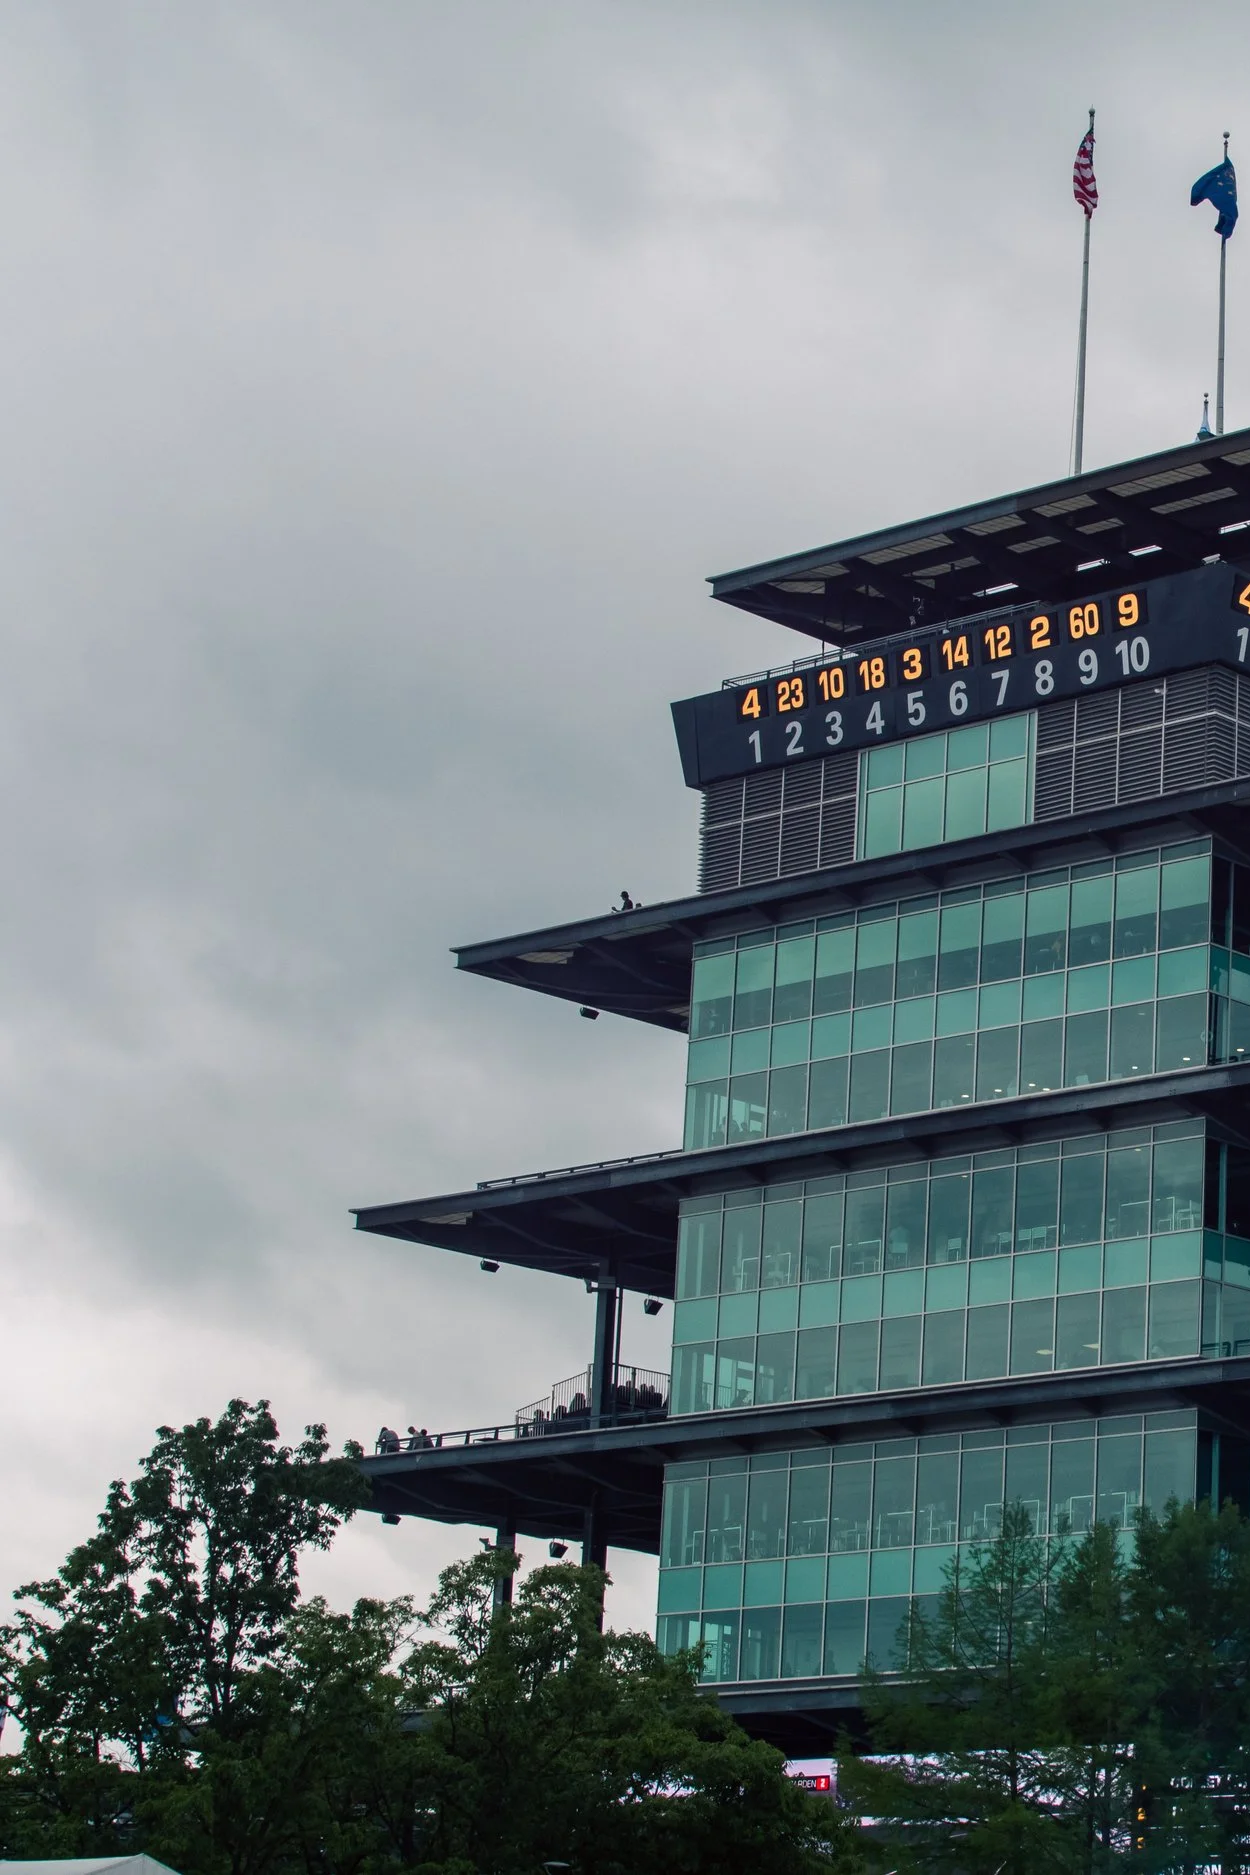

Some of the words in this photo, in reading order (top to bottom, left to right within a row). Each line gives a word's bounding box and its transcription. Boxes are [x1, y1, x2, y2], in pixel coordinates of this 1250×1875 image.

[741, 688, 761, 718] 4
[777, 677, 804, 713] 23
[818, 667, 845, 701] 10
[858, 657, 885, 690] 18
[902, 647, 923, 680] 3
[942, 635, 969, 670] 14
[984, 625, 1012, 660] 12
[1030, 615, 1051, 649] 2
[1069, 602, 1100, 639] 60
[1117, 593, 1139, 627] 9
[748, 730, 762, 764] 1
[785, 720, 804, 756] 2
[825, 710, 844, 746] 3
[865, 700, 885, 735] 4
[907, 690, 926, 726] 5
[949, 680, 968, 716] 6
[991, 668, 1010, 706] 7
[1034, 659, 1055, 696] 8
[1078, 648, 1099, 685] 9
[1114, 636, 1150, 676] 10
[1236, 626, 1250, 663] 1
